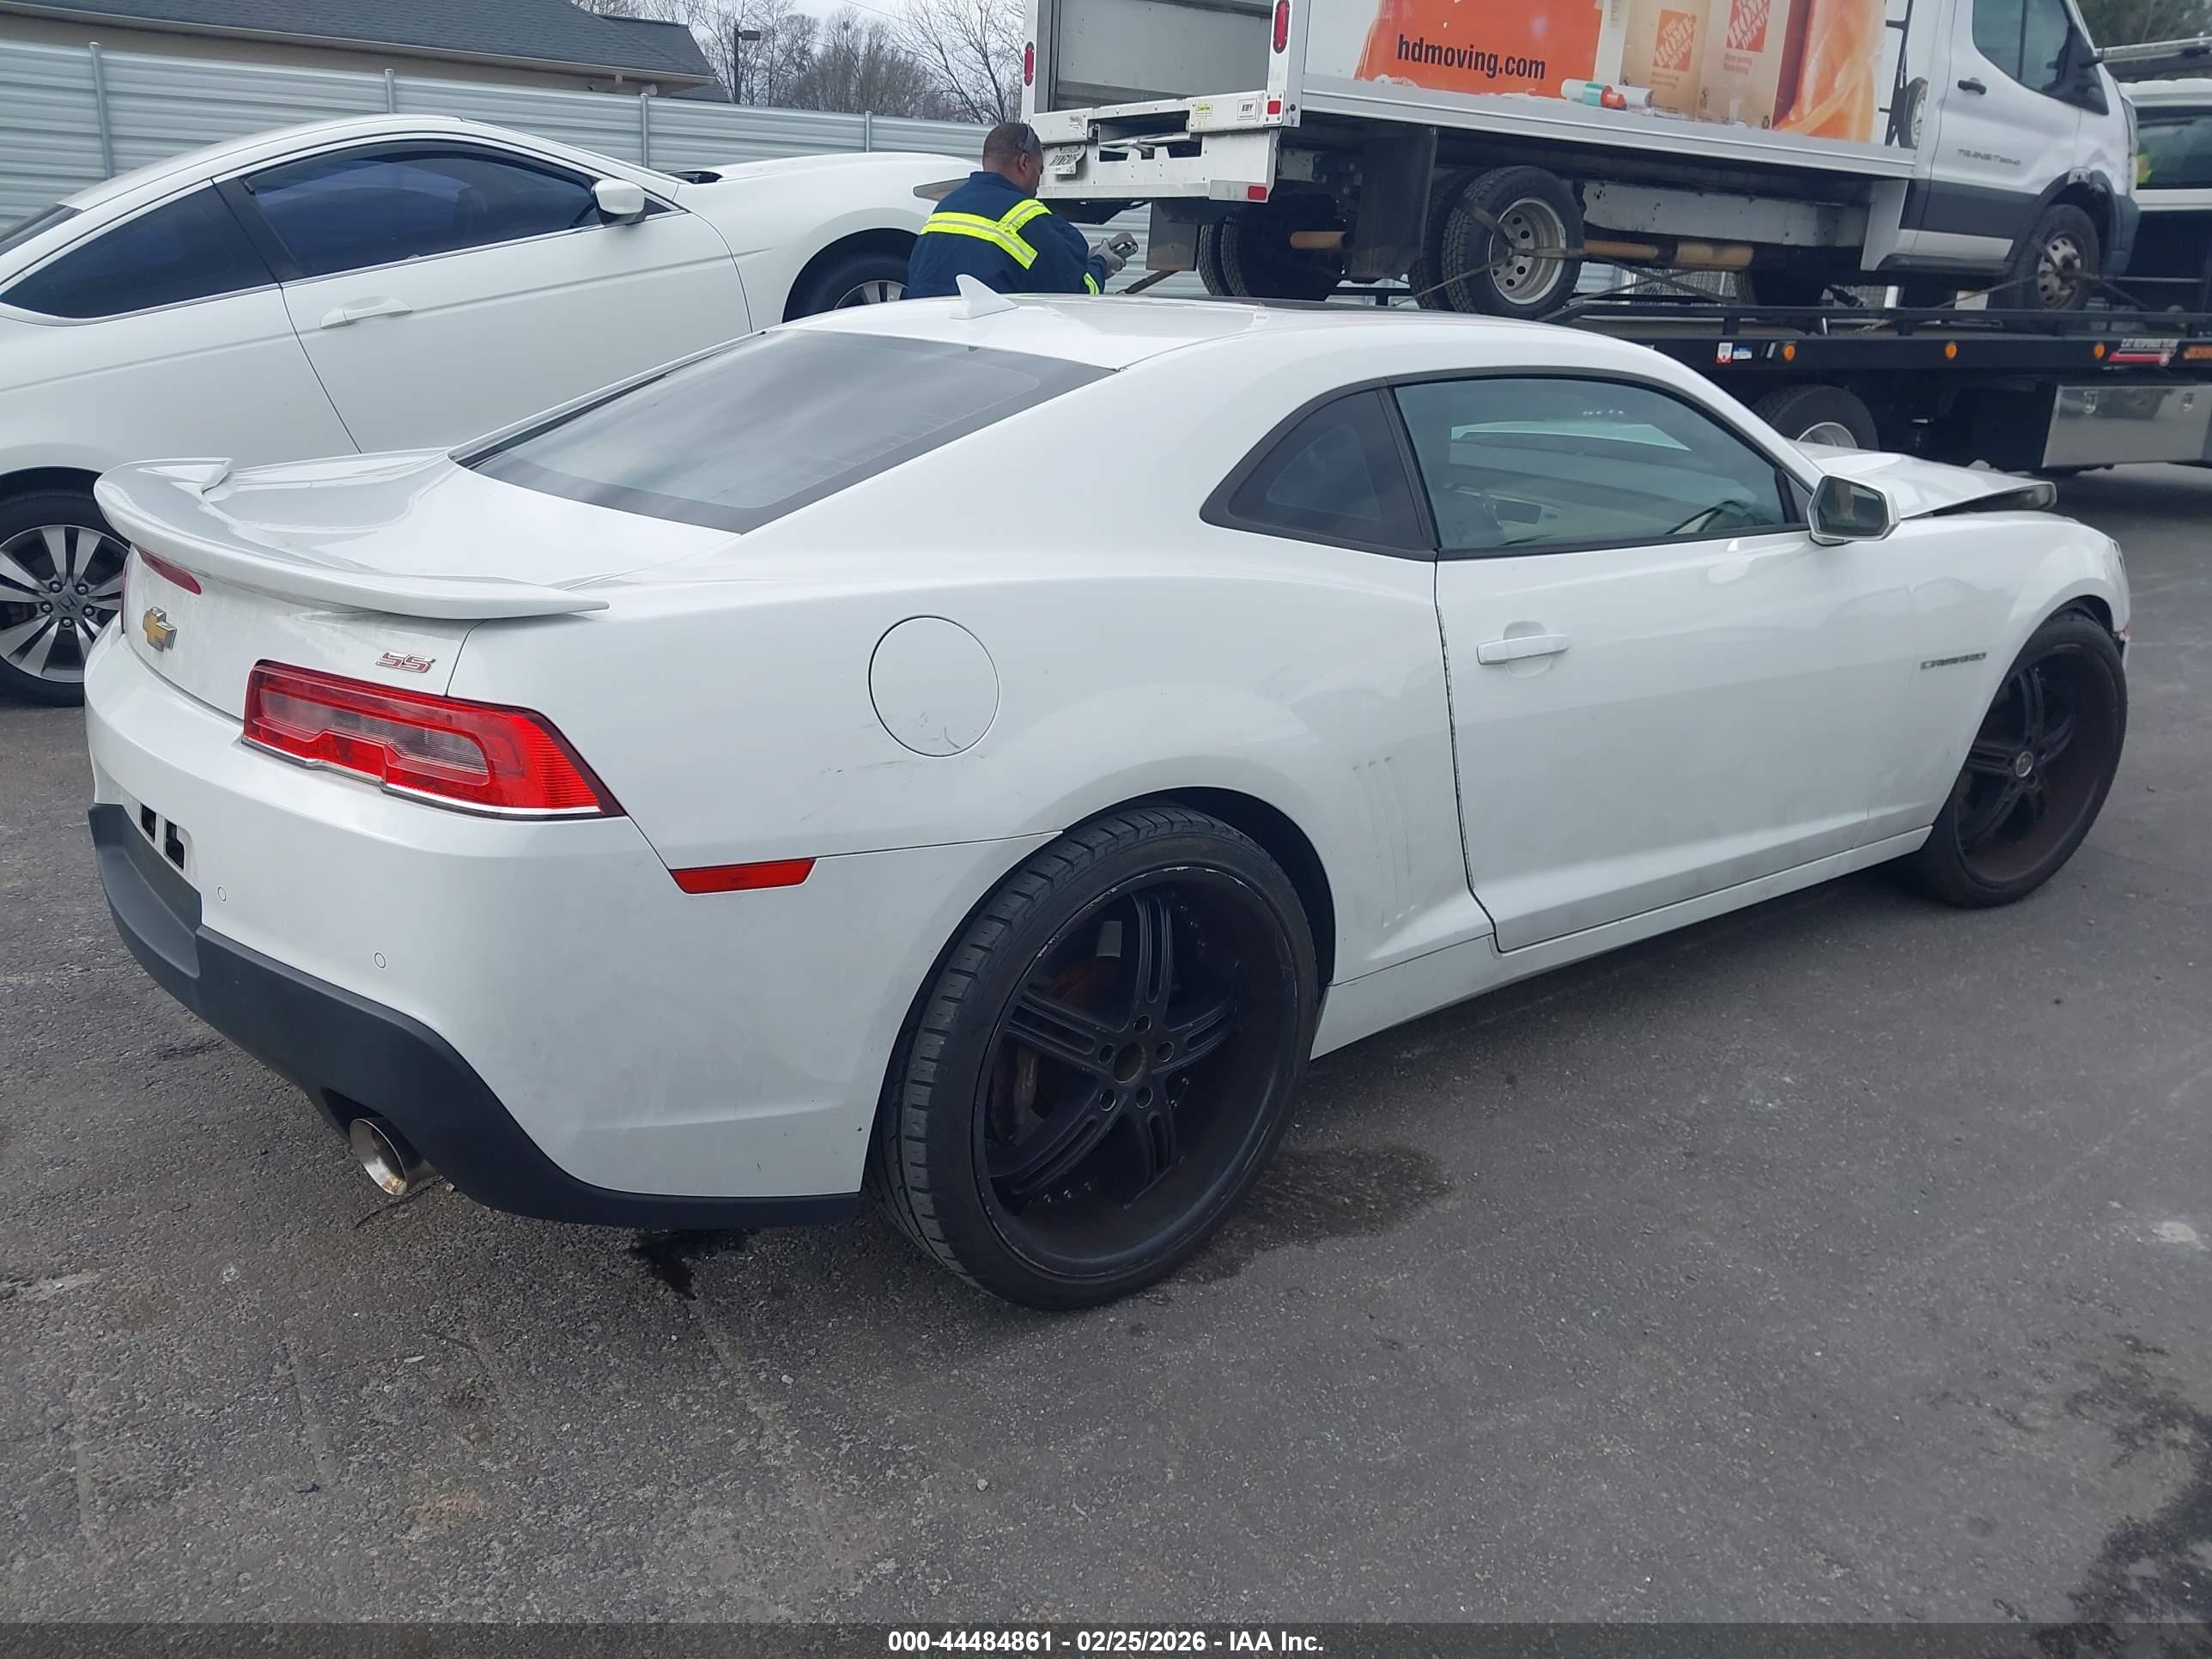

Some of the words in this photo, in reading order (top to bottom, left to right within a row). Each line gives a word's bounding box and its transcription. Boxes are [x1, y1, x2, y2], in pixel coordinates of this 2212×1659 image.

[1727, 0, 1768, 49] HOM
[1397, 34, 1546, 79] hdmoving.com
[375, 651, 436, 673] SS
